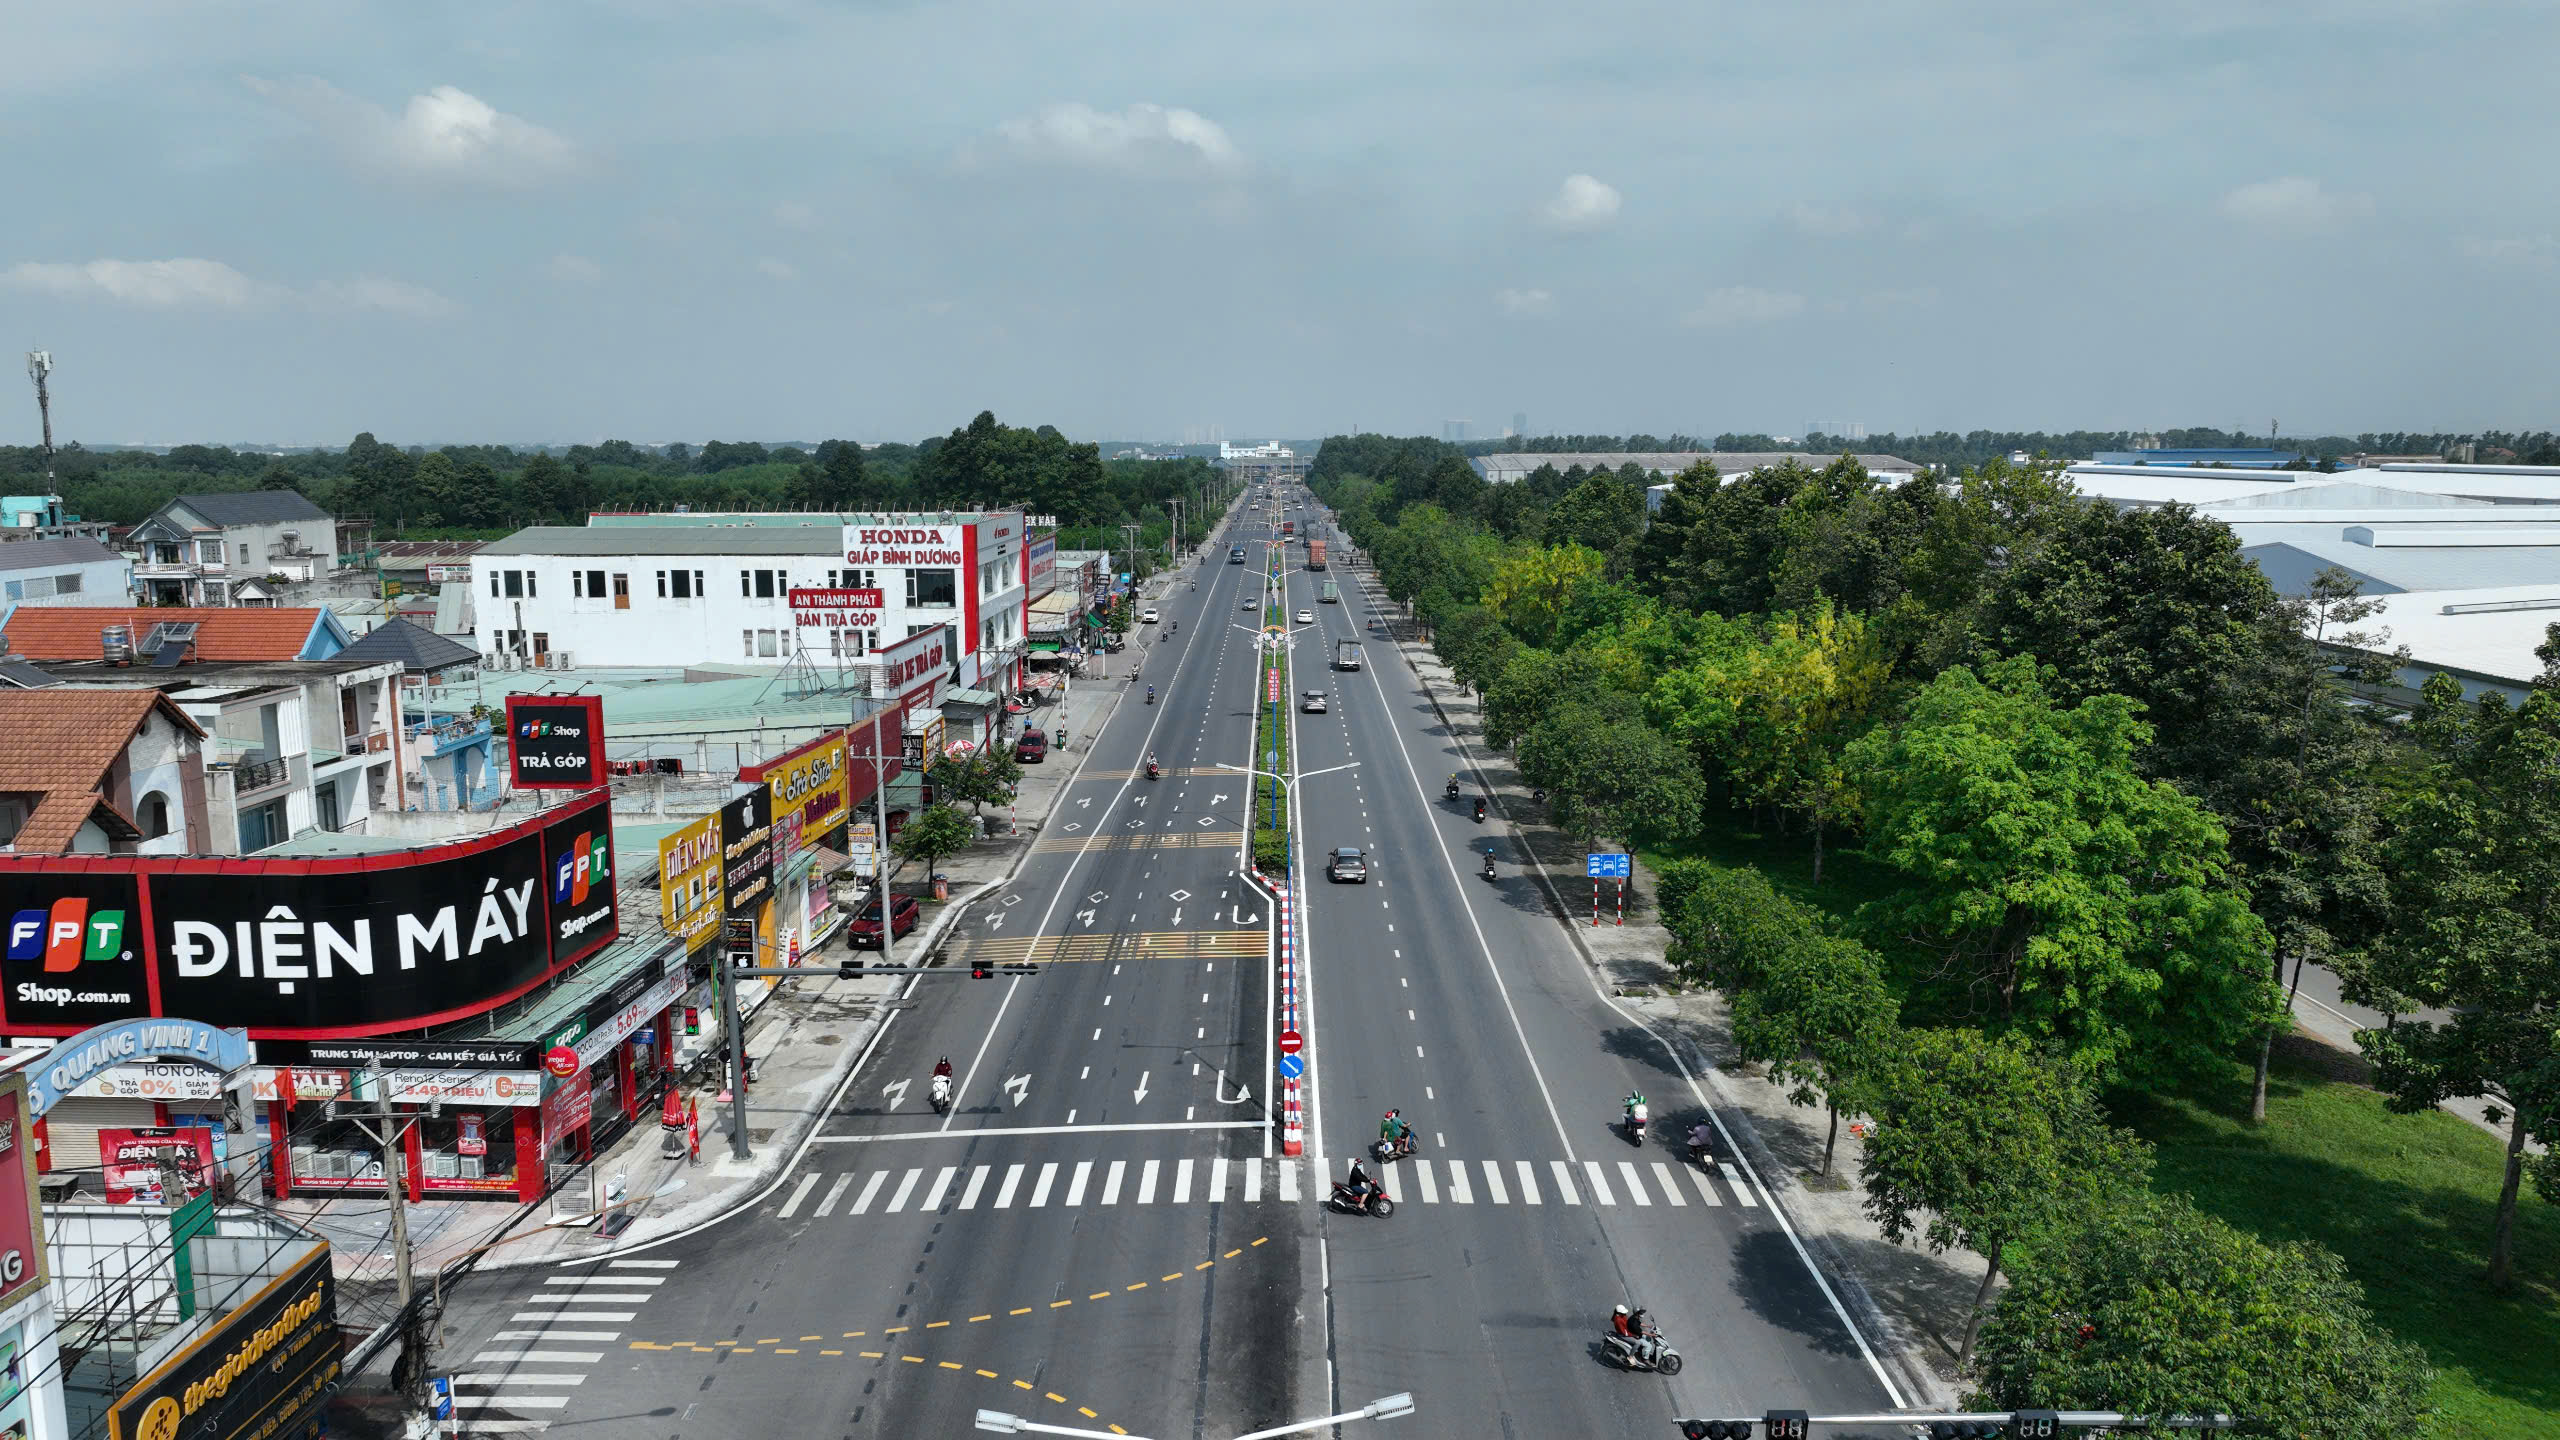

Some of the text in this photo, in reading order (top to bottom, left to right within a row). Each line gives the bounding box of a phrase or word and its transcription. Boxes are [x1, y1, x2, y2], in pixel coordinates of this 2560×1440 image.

[860, 529, 944, 544] HONDA
[848, 546, 961, 565] GIÁP BÌNH DƯƠNG
[795, 588, 876, 606] AN THÀNH PHÁT
[796, 607, 877, 627] BÁN TRẢ GÓP
[905, 657, 915, 681] XE
[915, 644, 929, 677] TRẢ
[929, 638, 943, 668] GÓP
[520, 752, 587, 768] TRẢ GÓP
[558, 846, 606, 892] FPT
[560, 906, 610, 939] Shop.com.vn
[172, 877, 535, 994] ĐIỆN MÁY
[17, 982, 131, 1006] Shop.com.vn
[617, 1004, 638, 1035] 5.69
[52, 1025, 211, 1091] QUANG VINH 1
[310, 1049, 349, 1059] TRUNG
[350, 1048, 374, 1059] TÂM
[427, 1051, 452, 1061] CAM
[477, 1050, 497, 1062] GIÁ
[144, 1064, 207, 1077] HONOR
[394, 1073, 436, 1084] Reno12
[438, 1075, 473, 1084] Series
[140, 1079, 177, 1095] 0%
[404, 1085, 440, 1096] 9.49
[118, 1144, 157, 1160] ĐIỆN
